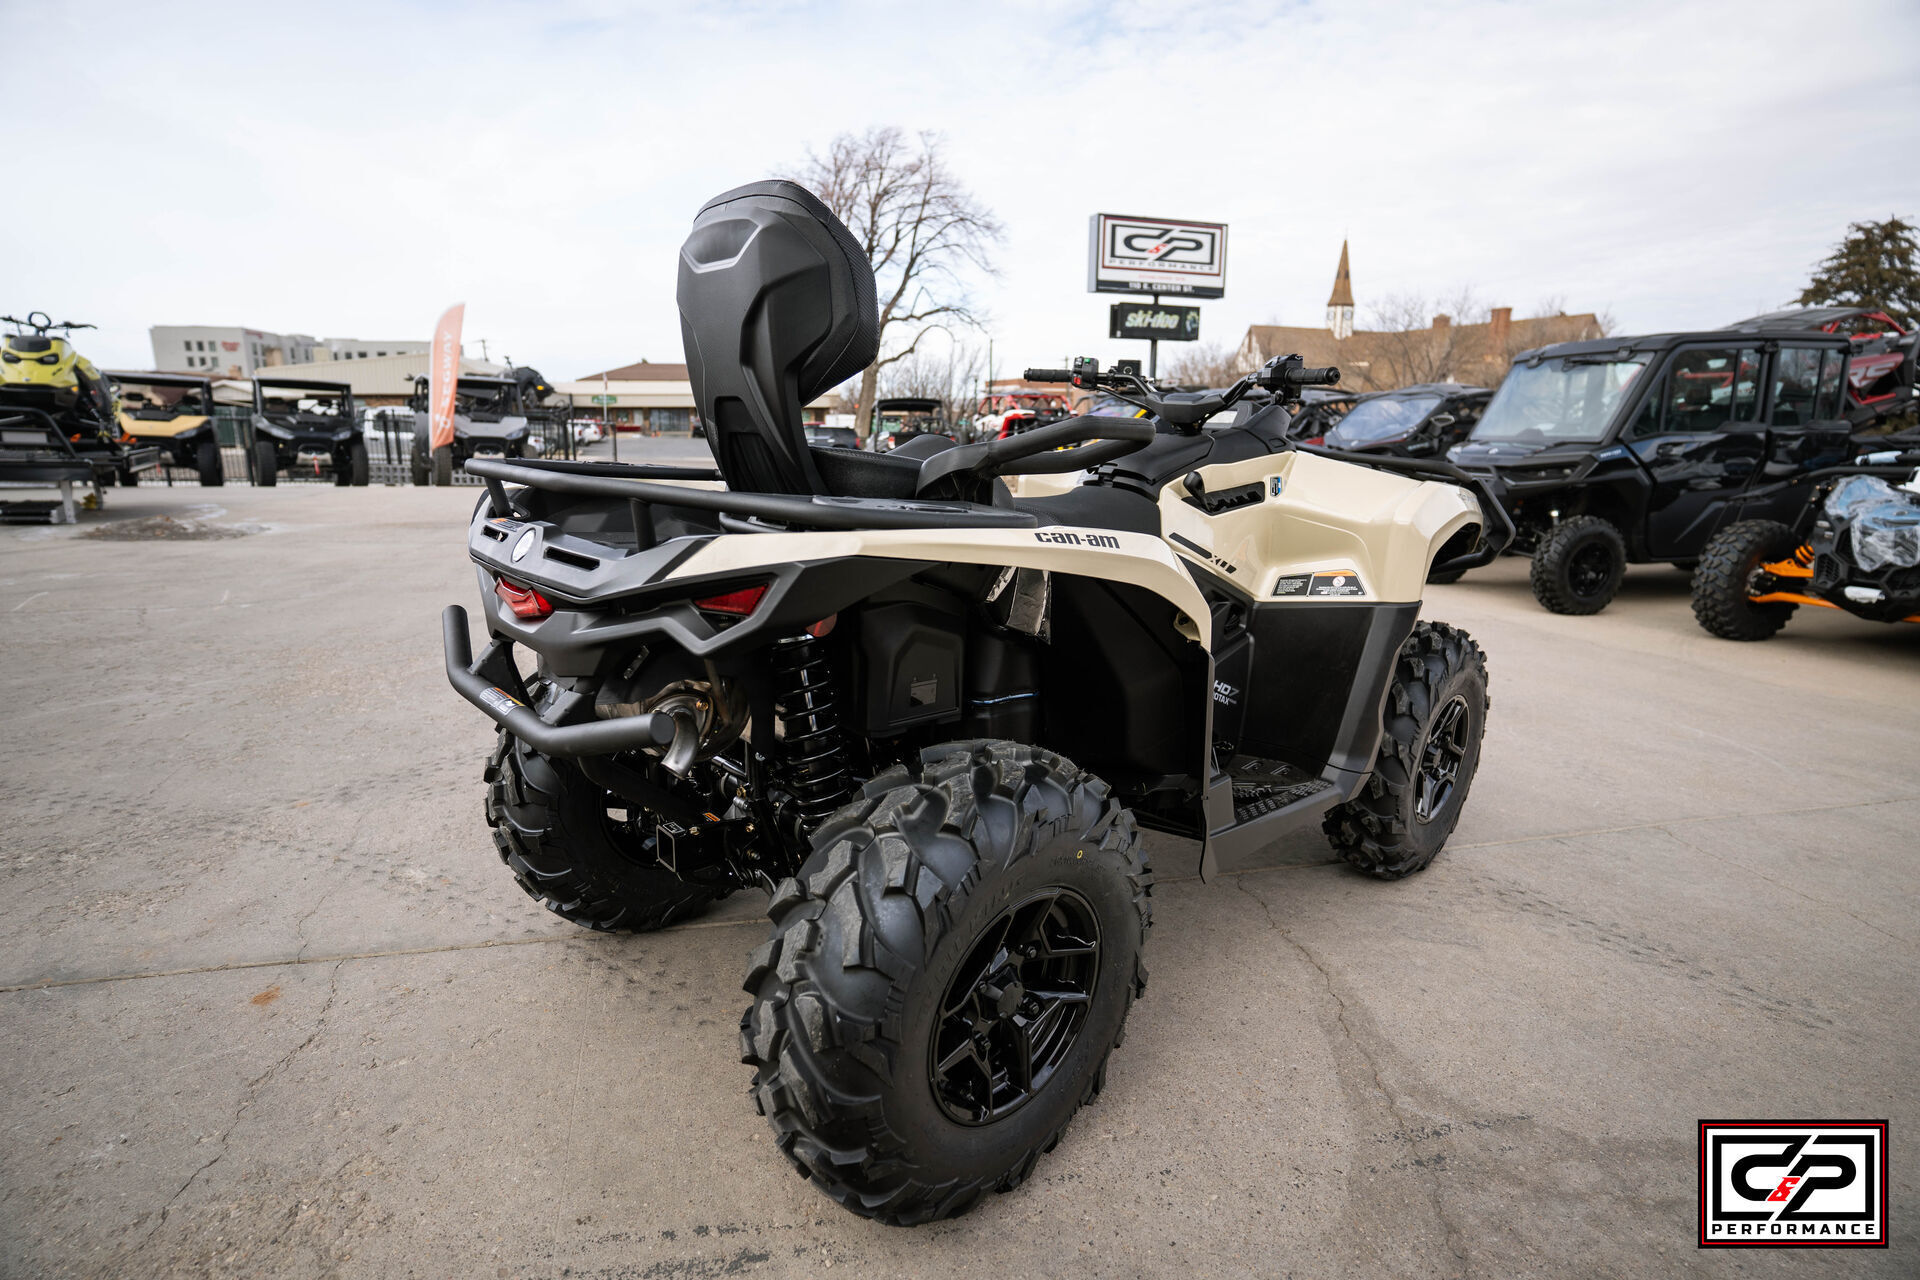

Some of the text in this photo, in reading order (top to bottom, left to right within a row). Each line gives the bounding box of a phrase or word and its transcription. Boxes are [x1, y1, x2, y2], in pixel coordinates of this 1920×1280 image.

[1108, 259, 1215, 272] PERFORMANCE
[1152, 283, 1182, 292] CENTER
[1125, 310, 1180, 329] ski-doo
[441, 331, 453, 408] SEGWAY
[1034, 532, 1120, 549] can-am
